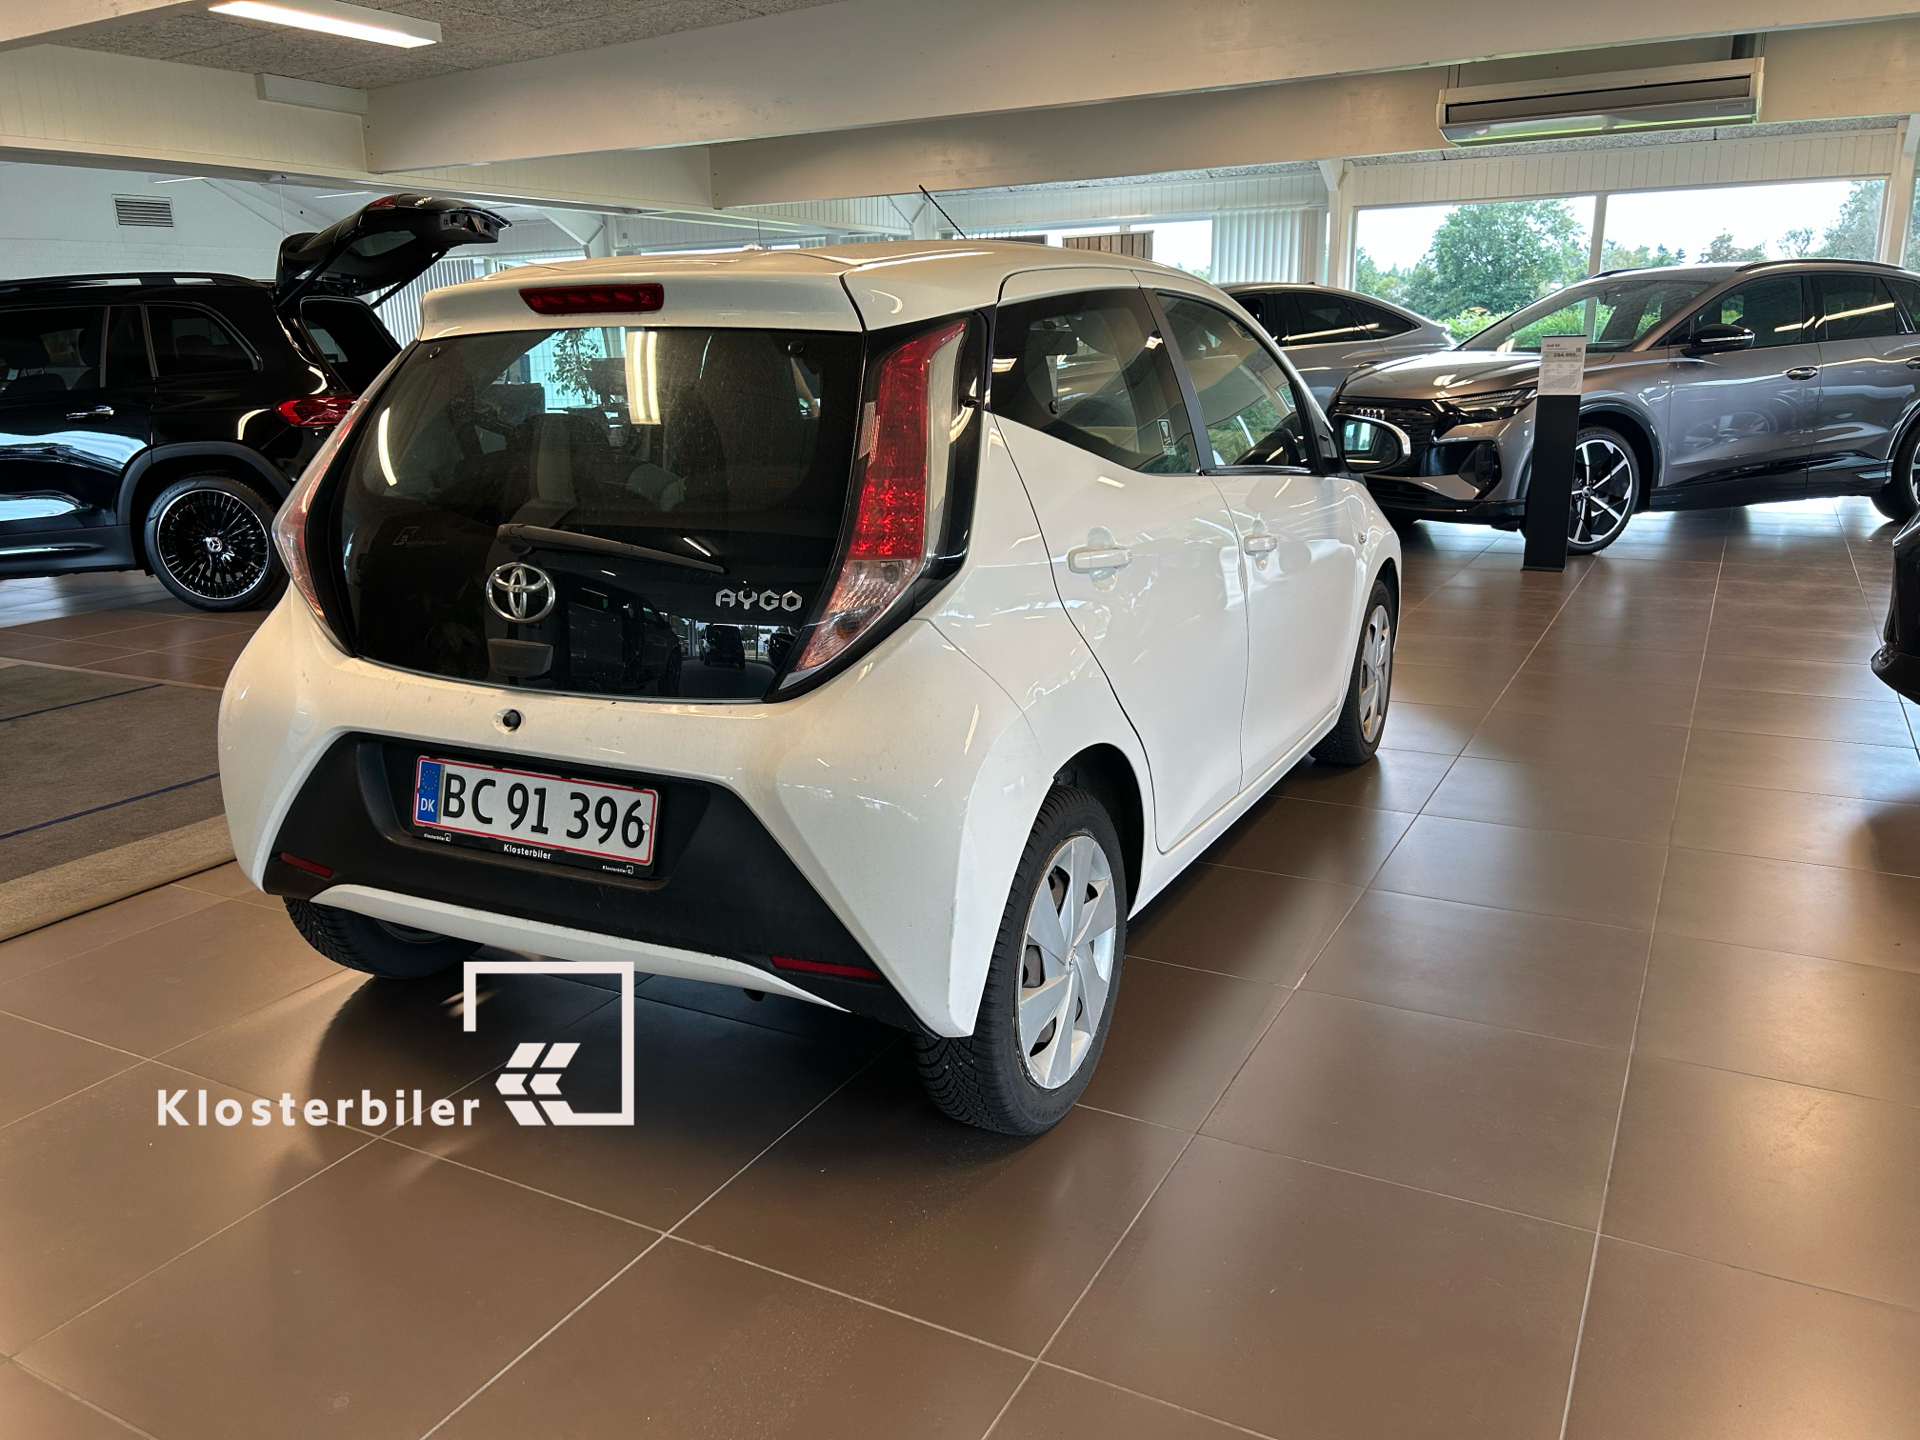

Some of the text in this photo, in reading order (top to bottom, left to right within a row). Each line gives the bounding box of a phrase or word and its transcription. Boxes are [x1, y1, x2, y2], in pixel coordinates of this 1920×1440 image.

[714, 587, 803, 613] AYGO
[420, 798, 435, 813] DK
[442, 772, 646, 849] BC 91 396
[503, 843, 552, 860] Klosterbiler
